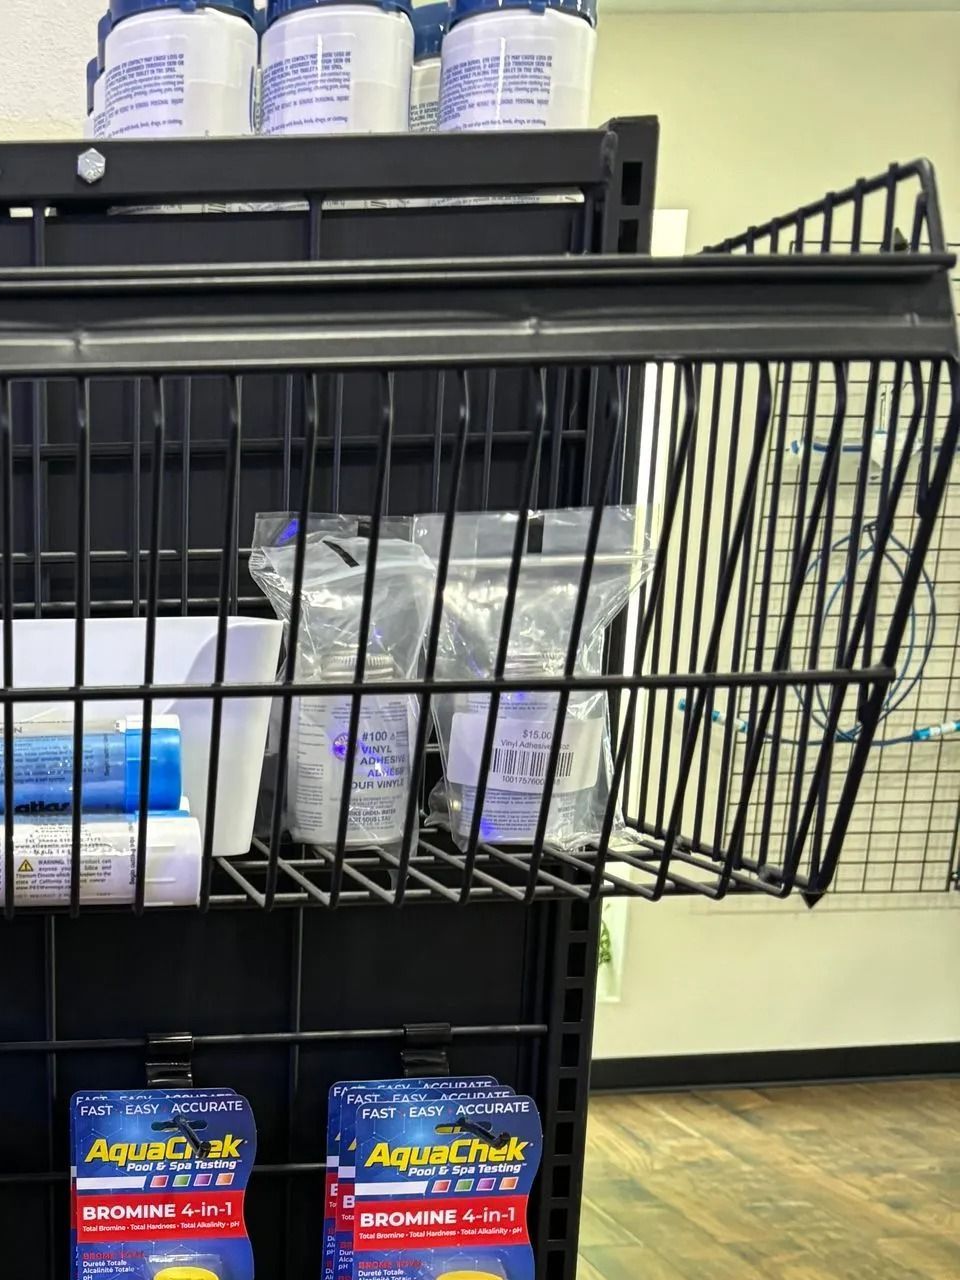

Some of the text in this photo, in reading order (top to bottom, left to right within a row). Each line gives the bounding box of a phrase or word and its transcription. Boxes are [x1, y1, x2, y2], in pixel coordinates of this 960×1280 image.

[362, 731, 387, 741] #100
[361, 745, 392, 754] VINYL
[501, 739, 518, 748] Vinyl
[351, 781, 374, 790] OUR
[80, 1101, 243, 1116] FAST EASY ACCURATE
[362, 1102, 530, 1119] FAST EASY ACCURATE
[84, 1134, 244, 1166] AquaCek
[127, 1162, 152, 1172] Pool
[156, 1161, 166, 1170] &
[169, 1160, 192, 1171] Spa
[408, 1167, 436, 1177] Pool
[439, 1166, 450, 1175] &
[452, 1165, 475, 1176] Spa
[83, 1202, 232, 1221] BROMINE 4-in-1
[359, 1207, 515, 1228] BROMINE 4-in-1
[197, 1221, 226, 1229] Alkalinity
[230, 1221, 240, 1229] pH
[376, 1231, 405, 1239] Bromine
[426, 1229, 457, 1237] Hardness
[478, 1227, 508, 1236] Alkalinity
[512, 1227, 522, 1235] pH
